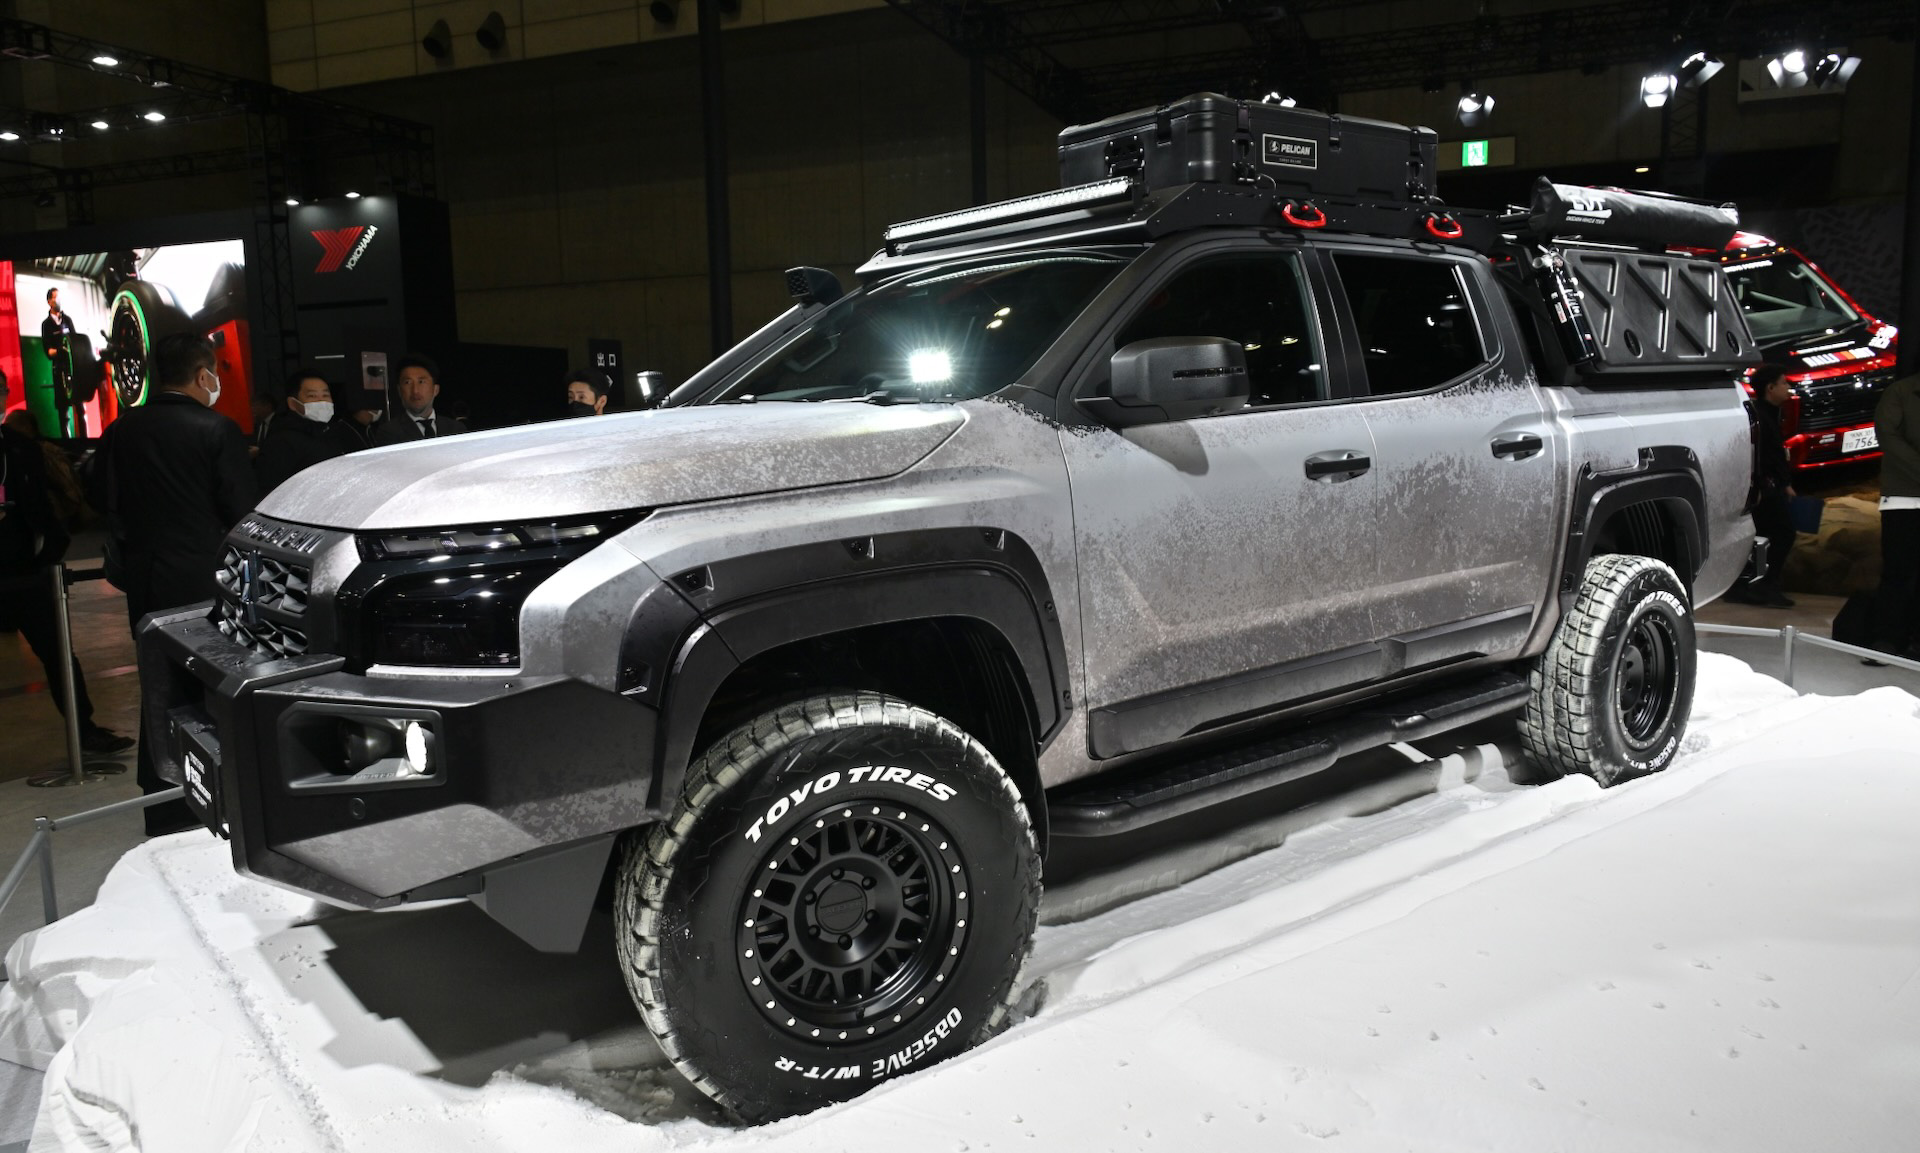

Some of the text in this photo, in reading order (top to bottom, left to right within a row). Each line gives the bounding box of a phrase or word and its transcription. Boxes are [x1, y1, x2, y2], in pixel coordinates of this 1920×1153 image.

[1281, 143, 1311, 156] PELICAN
[345, 224, 378, 271] YOKOHAMA
[597, 352, 616, 367] 出口
[1655, 591, 1686, 616] TIRES
[745, 765, 958, 843] TOYO TIRES
[774, 1006, 963, 1080] OBSERVE W/T-R
